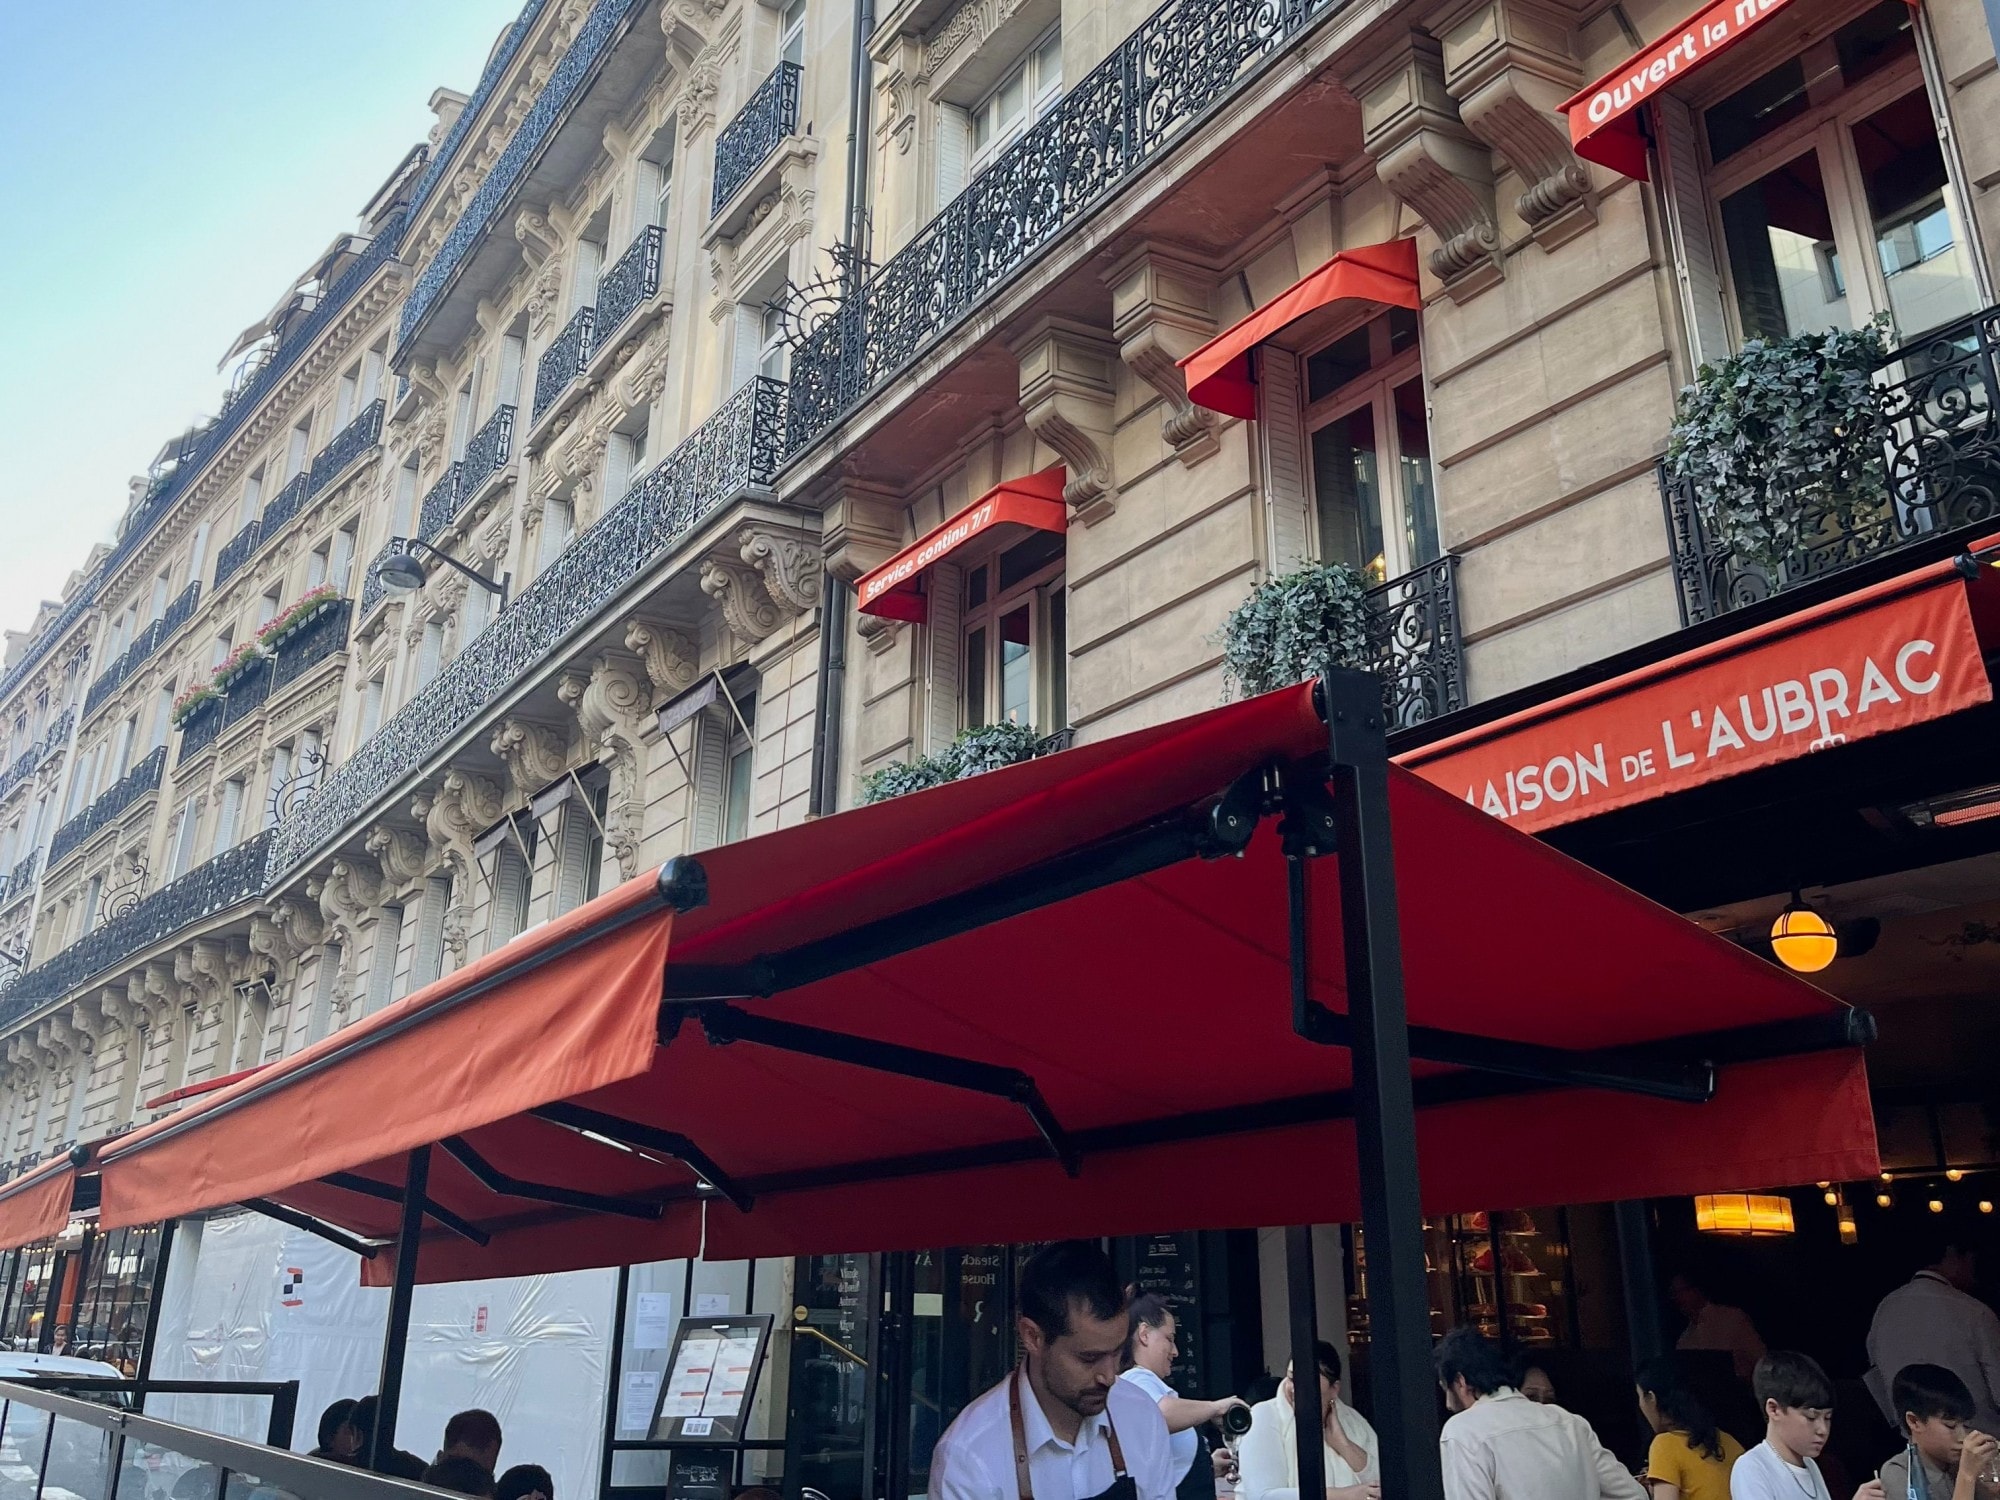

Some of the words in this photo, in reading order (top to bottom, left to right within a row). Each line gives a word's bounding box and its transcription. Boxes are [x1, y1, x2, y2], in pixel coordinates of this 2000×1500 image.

[1588, 33, 1697, 123] Ouvert
[1702, 19, 1728, 48] la
[866, 558, 913, 599] Service
[917, 522, 968, 566] continu
[971, 503, 992, 530] 7/7
[1464, 742, 1609, 819] AISON
[1621, 747, 1656, 783] DE
[1661, 639, 1941, 770] L'AUBRAC
